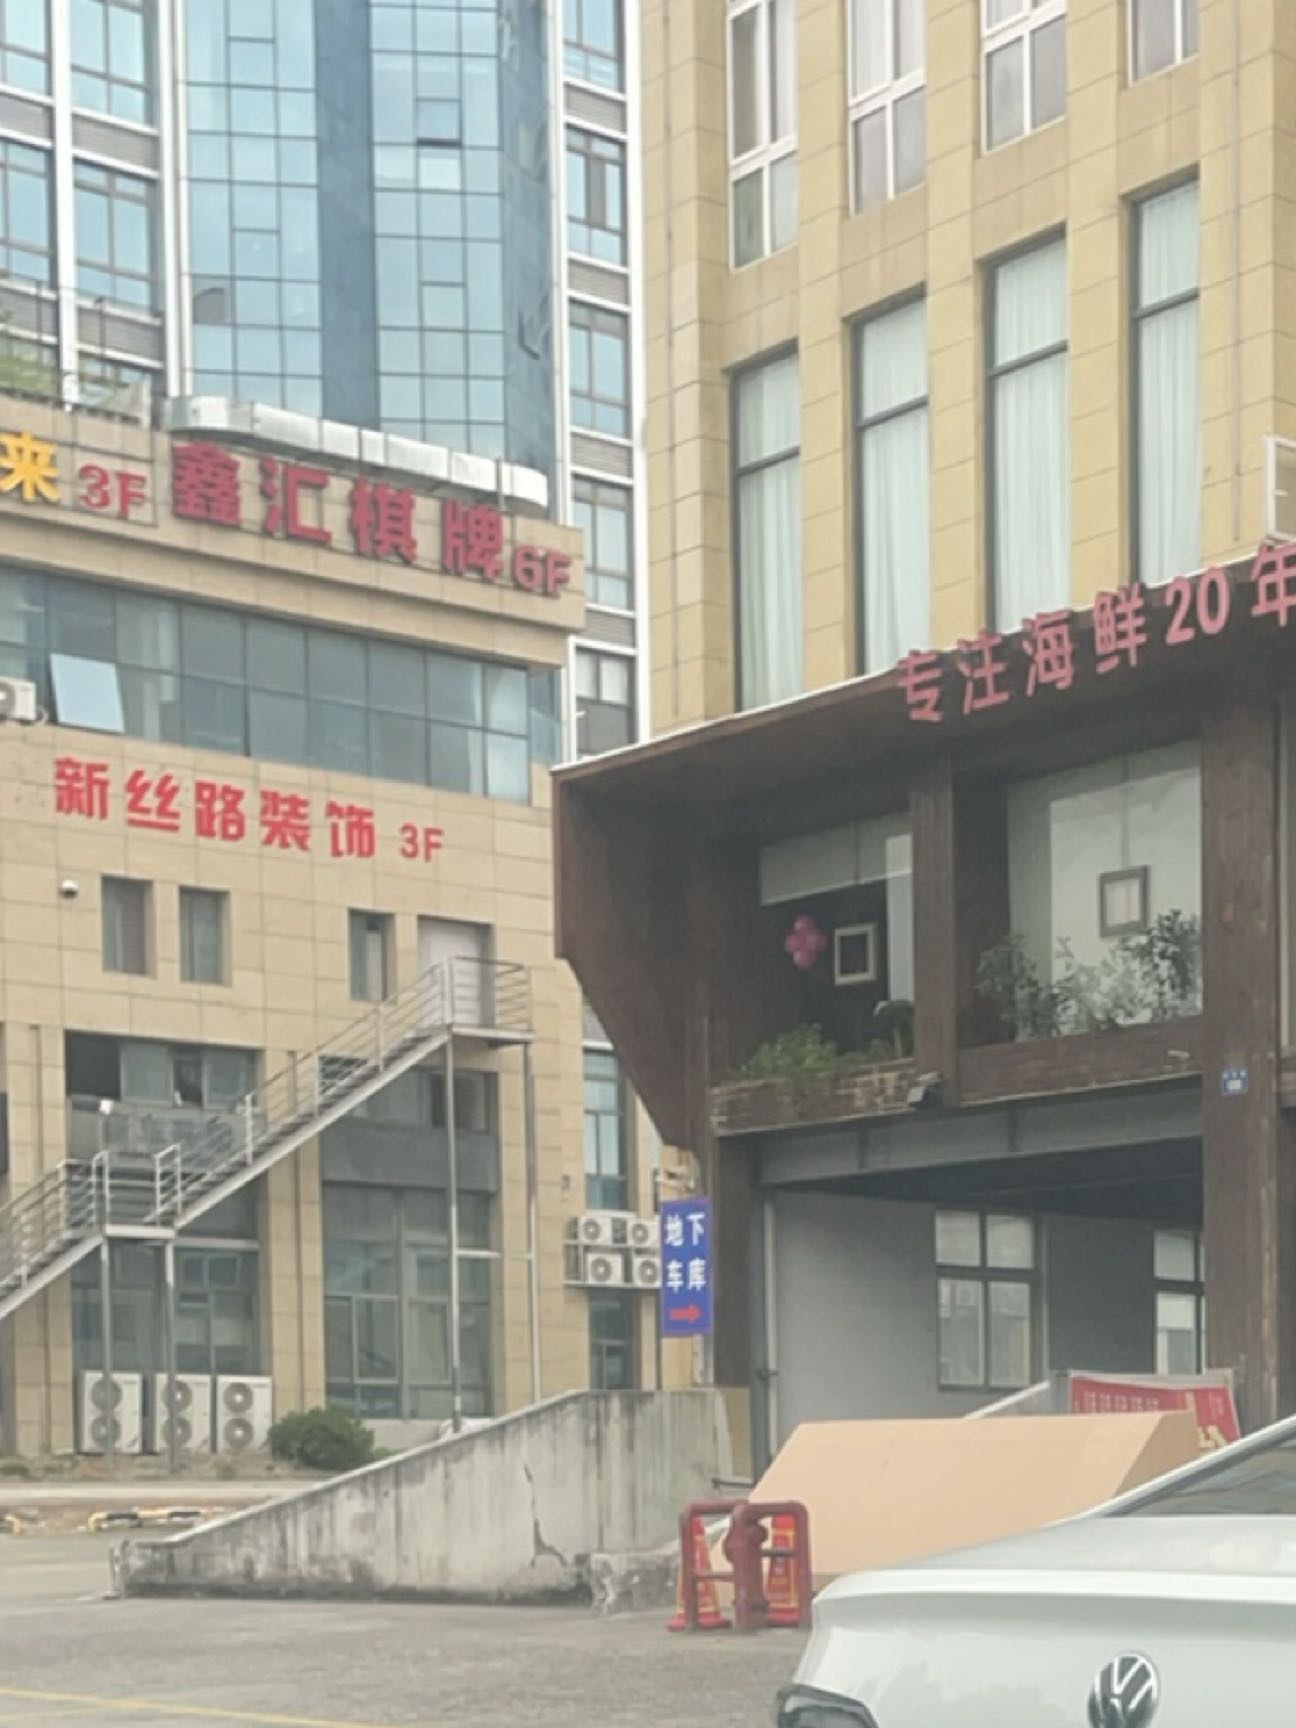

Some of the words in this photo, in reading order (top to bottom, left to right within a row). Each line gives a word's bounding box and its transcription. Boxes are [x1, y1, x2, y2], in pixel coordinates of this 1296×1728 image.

[0, 431, 60, 502] 来
[78, 463, 147, 521] 3F
[171, 441, 504, 579] 鑫汇棋牌
[511, 544, 572, 598] 6F
[54, 757, 377, 859] 新丝路装饰
[400, 823, 444, 863] 3F
[664, 1211, 706, 1248] 地下
[666, 1257, 707, 1295] 车库
